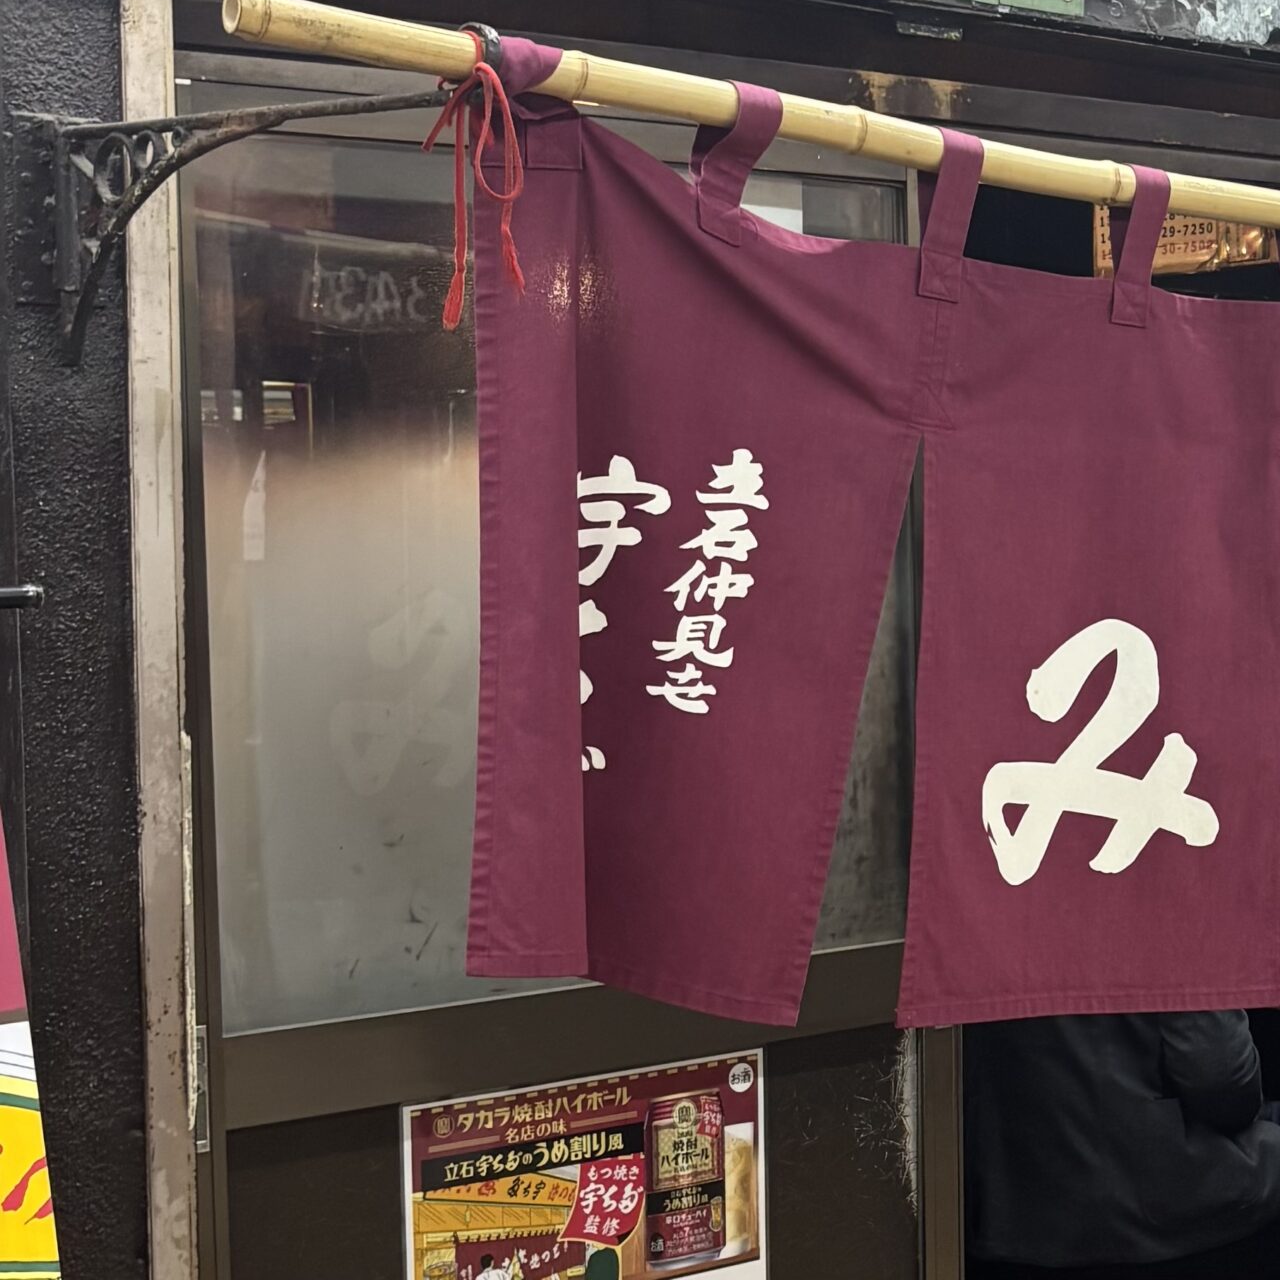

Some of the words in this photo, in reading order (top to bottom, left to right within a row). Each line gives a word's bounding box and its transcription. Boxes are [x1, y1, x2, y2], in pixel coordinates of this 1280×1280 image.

[731, 1067, 751, 1085] お酒
[457, 1086, 632, 1133] タカラ焼酎ハイボール
[505, 1119, 568, 1145] 名店の味
[660, 1148, 710, 1167] ハイボール
[587, 1164, 640, 1181] もつ焼き
[583, 1216, 620, 1237] 監修
